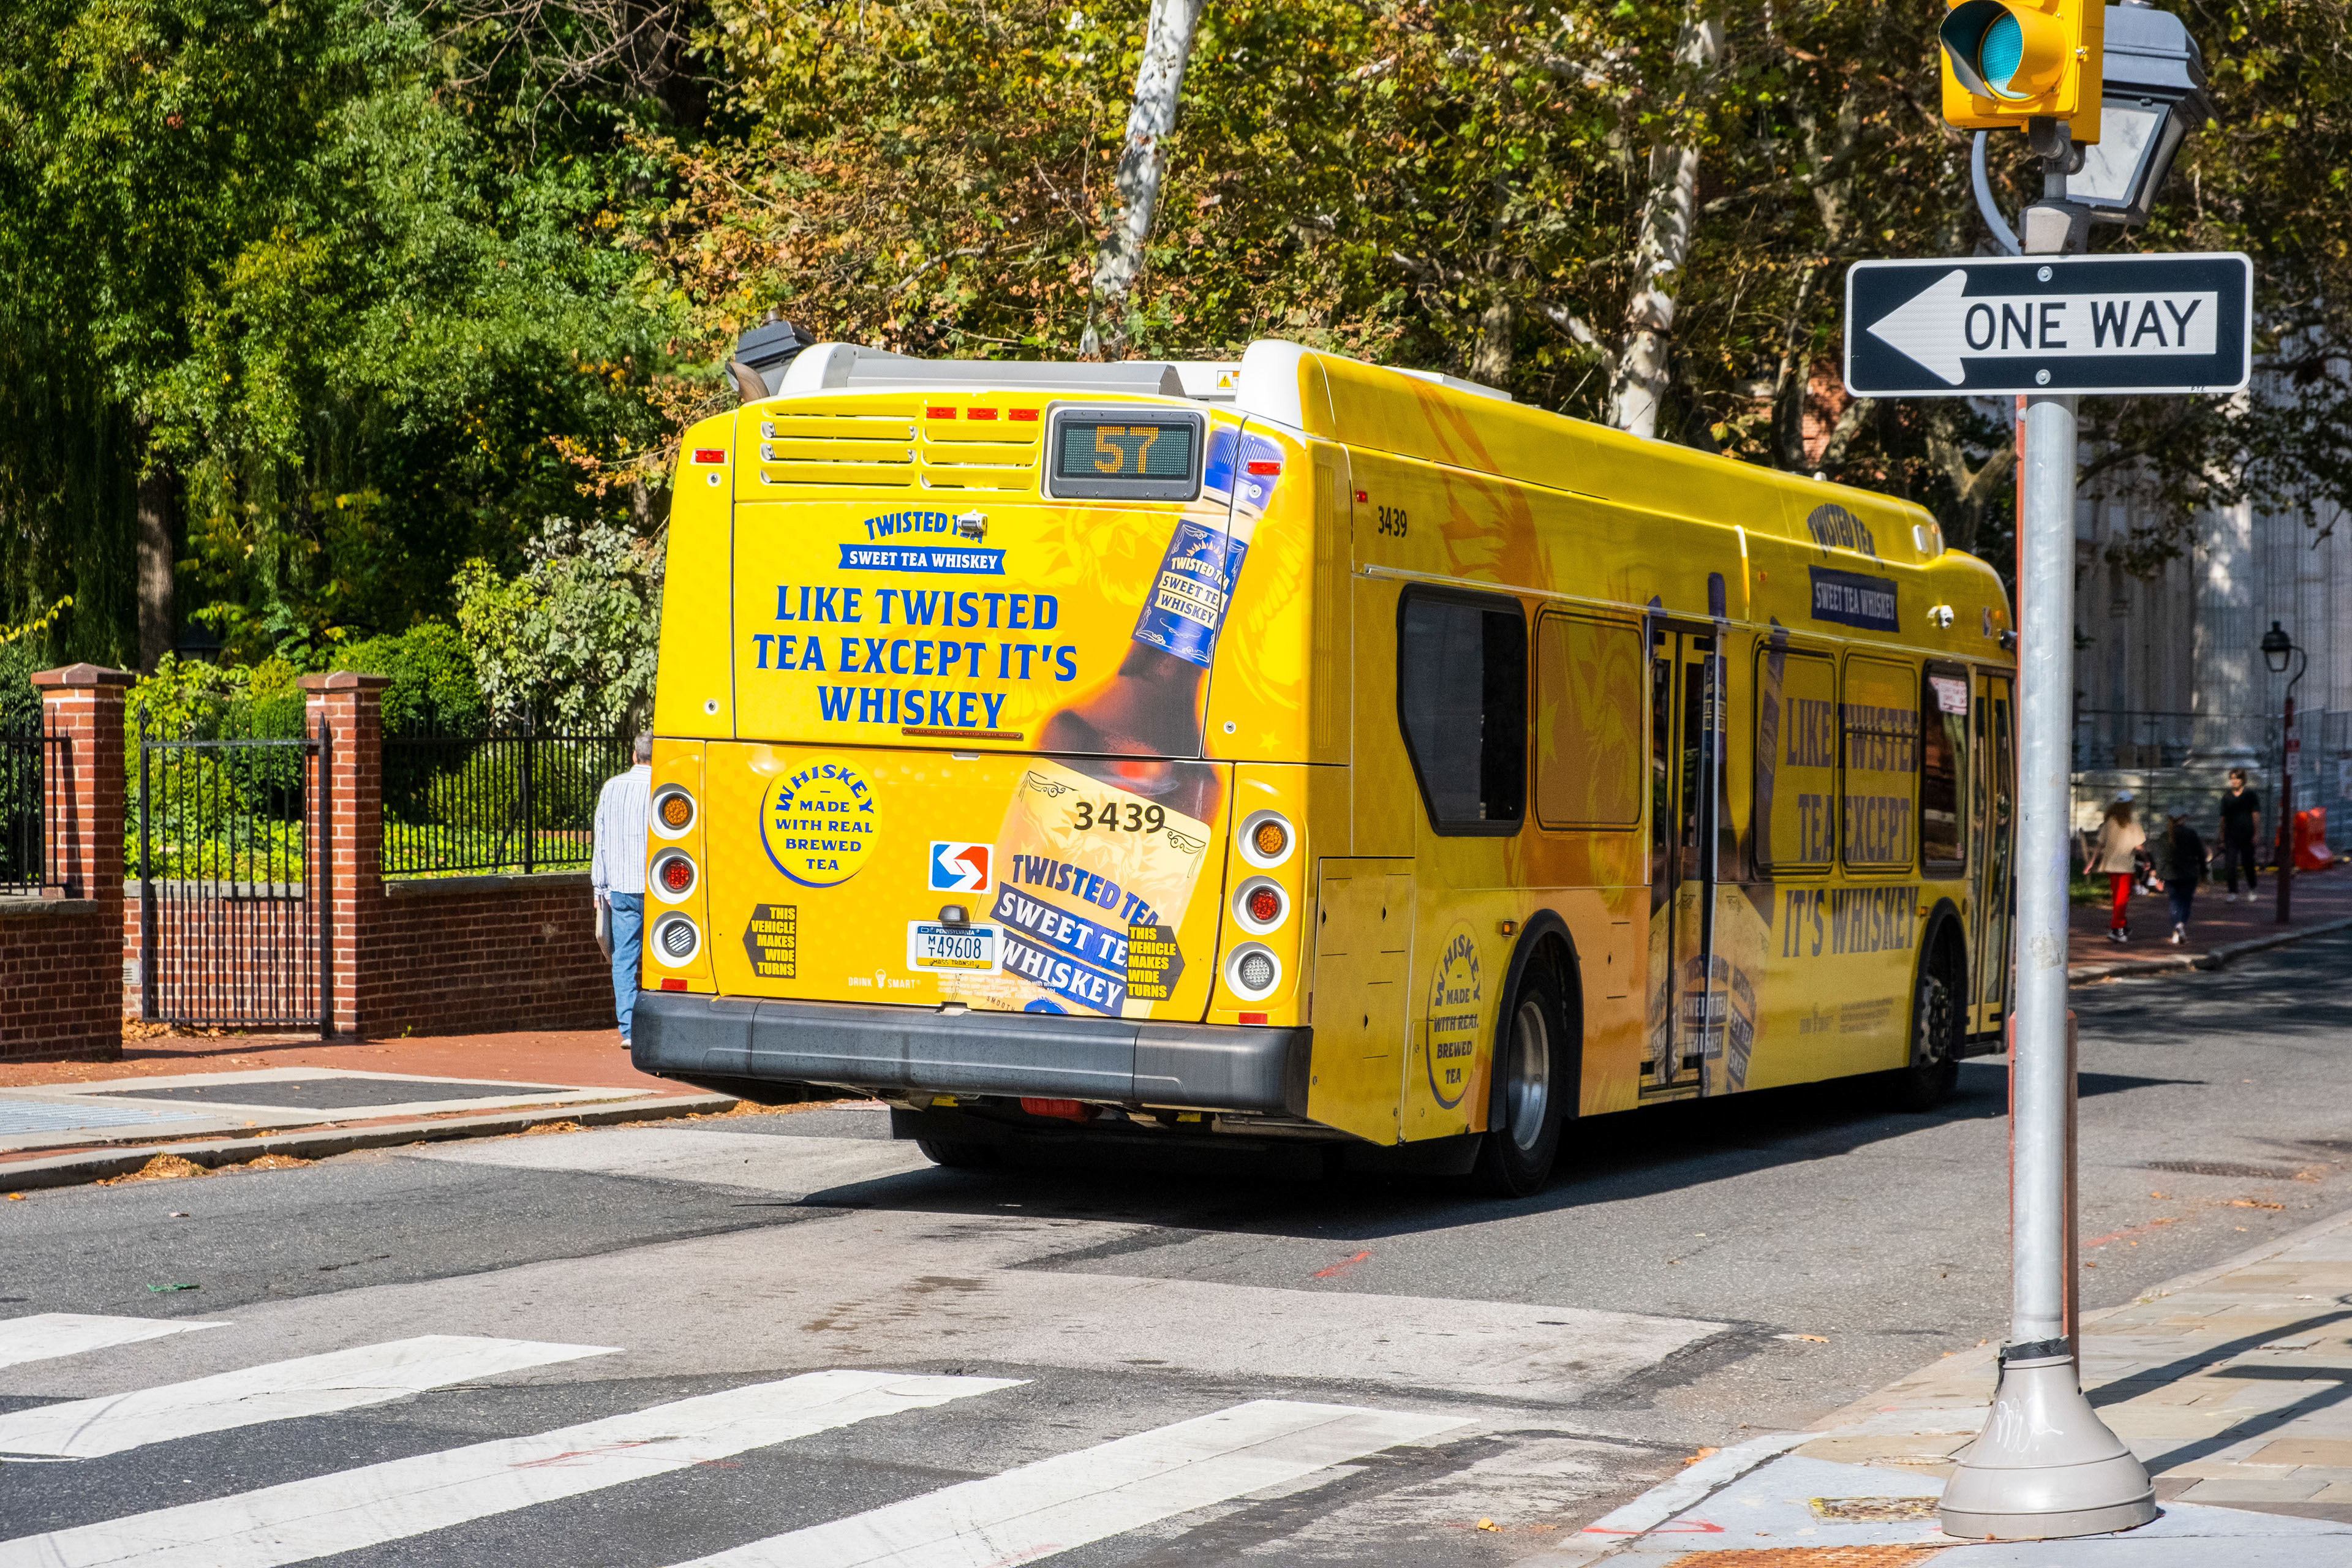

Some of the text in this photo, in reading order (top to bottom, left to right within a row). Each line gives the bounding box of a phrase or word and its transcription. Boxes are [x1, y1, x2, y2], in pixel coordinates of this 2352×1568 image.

[1965, 300, 2203, 351] ONE WAY
[1095, 426, 1159, 473] 57
[864, 511, 948, 541] TWISTED
[1378, 505, 1407, 538] 3439
[850, 550, 998, 570] SWEET TEA WHISKEY
[1171, 557, 1216, 578] TWISTED
[1162, 576, 1220, 606] SWEET TE
[1815, 582, 1842, 612] SWEET
[1844, 586, 1860, 613] TEA
[775, 585, 1058, 630] LIKE TWISTED
[1160, 594, 1215, 624] WHISKEY
[752, 633, 1077, 682] TEA EXCEPT IT'S
[816, 685, 1007, 729] WHISKEY
[1786, 697, 1832, 767] LIKE
[775, 764, 875, 815] WHISKEY
[799, 800, 850, 813] MADE
[775, 818, 873, 834] WITH REAL
[1074, 801, 1166, 834] 3439
[1842, 794, 1910, 862] EXCEPT
[785, 839, 862, 852] BREWED
[805, 858, 840, 870] TEA
[1012, 854, 1121, 910] TWISTED
[769, 907, 796, 920] THIS
[1783, 886, 1920, 958] IT'S WHISKEY
[751, 919, 795, 934] VEHICLE
[999, 892, 1128, 968] SWEET TE
[1129, 927, 1157, 940] THIS
[756, 934, 795, 948] MAKES
[937, 936, 982, 959] 49608
[1128, 941, 1177, 956] VEHICLE
[764, 948, 794, 962] WIDE
[1128, 955, 1169, 970] MAKES
[757, 962, 794, 976] TURNS
[1001, 936, 1125, 1009] WHISKEY
[1128, 969, 1159, 983] WIDE
[1434, 934, 1480, 1006] WHISKEY
[848, 976, 873, 987] DRINK
[1127, 983, 1167, 998] TURNS
[987, 996, 1016, 1011] SMOOTH
[1446, 988, 1470, 1005] MADE
[1434, 1016, 1457, 1032] WITH
[1437, 1041, 1472, 1059] BREWED
[1446, 1068, 1461, 1084] TEA
